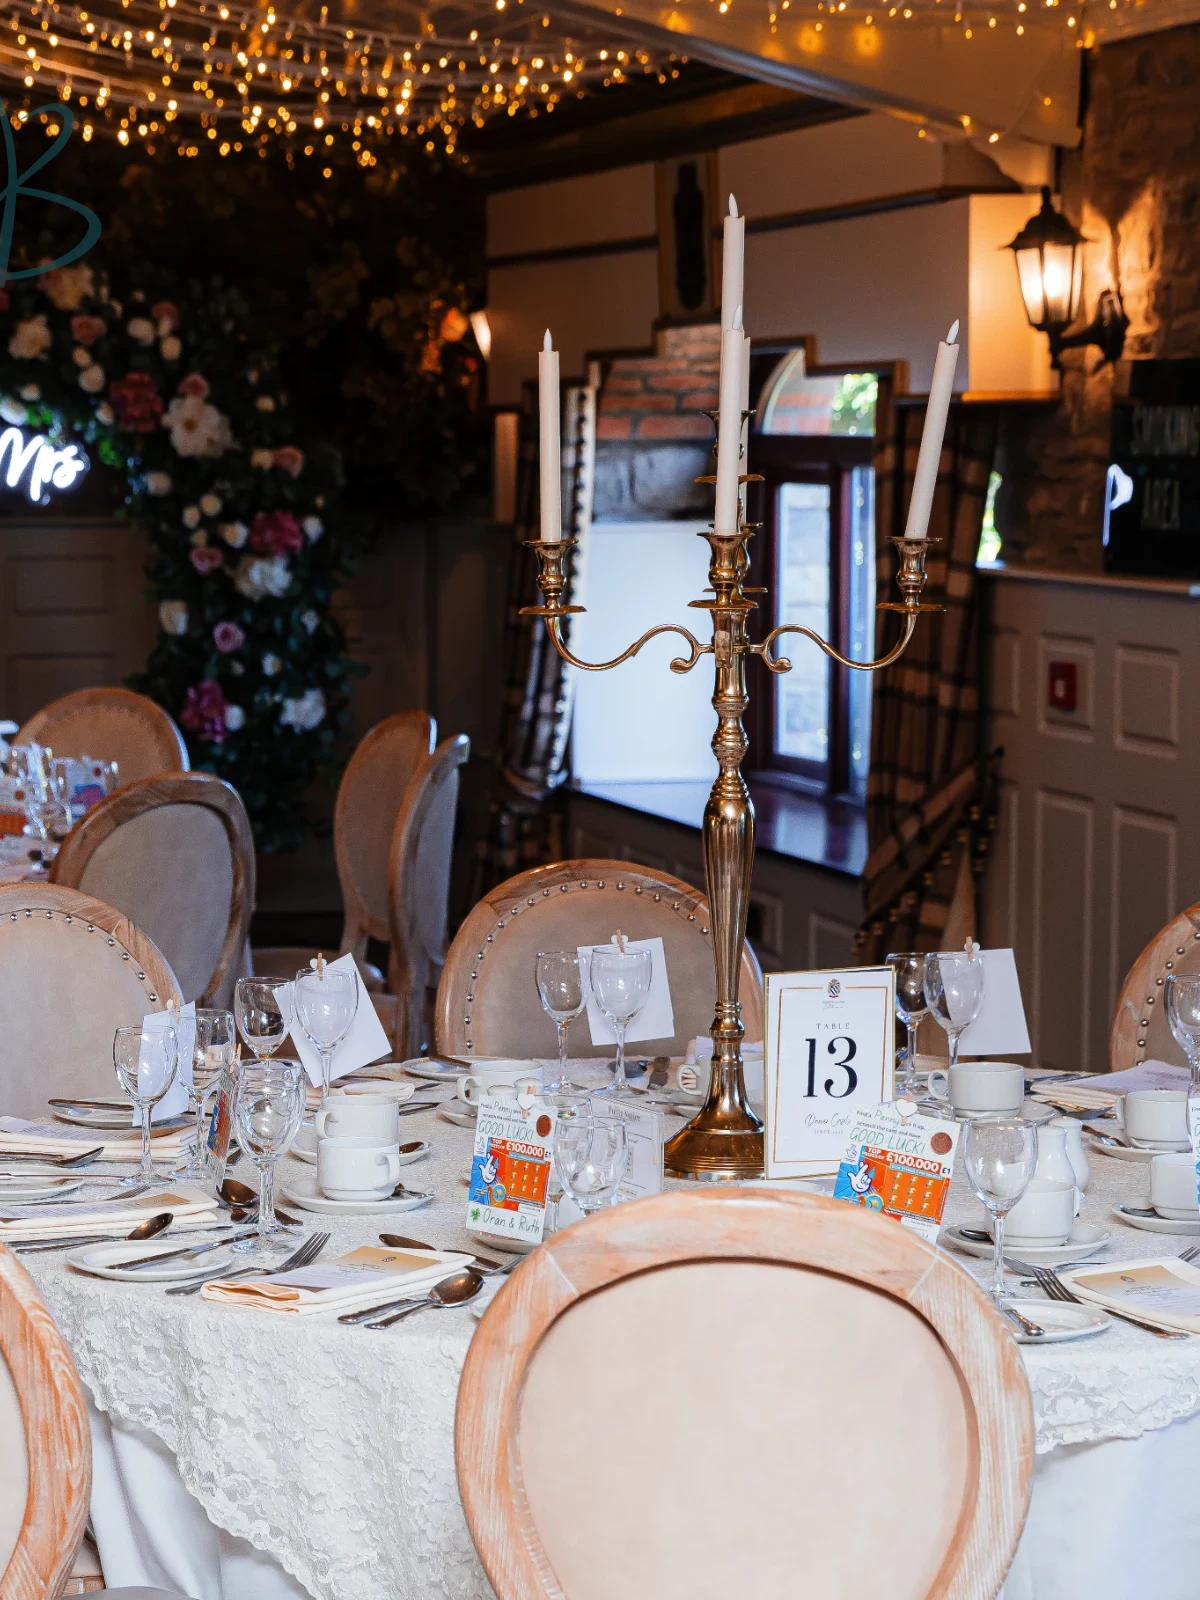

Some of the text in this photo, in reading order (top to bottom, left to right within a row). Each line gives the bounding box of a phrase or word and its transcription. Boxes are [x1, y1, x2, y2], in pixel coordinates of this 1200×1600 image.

[816, 1022, 850, 1030] TABLE
[802, 1036, 858, 1099] 13
[493, 1101, 513, 1118] Penny
[857, 1121, 876, 1129] scratch
[874, 1109, 900, 1129] Penny
[478, 1119, 534, 1142] GOOD LUCK!
[850, 1126, 927, 1155] GOOD LUCK!
[867, 1147, 882, 1155] TOP
[941, 1167, 951, 1175] £1
[483, 1207, 506, 1227] Oran
[508, 1217, 515, 1229] &
[519, 1215, 540, 1234] Ruth
